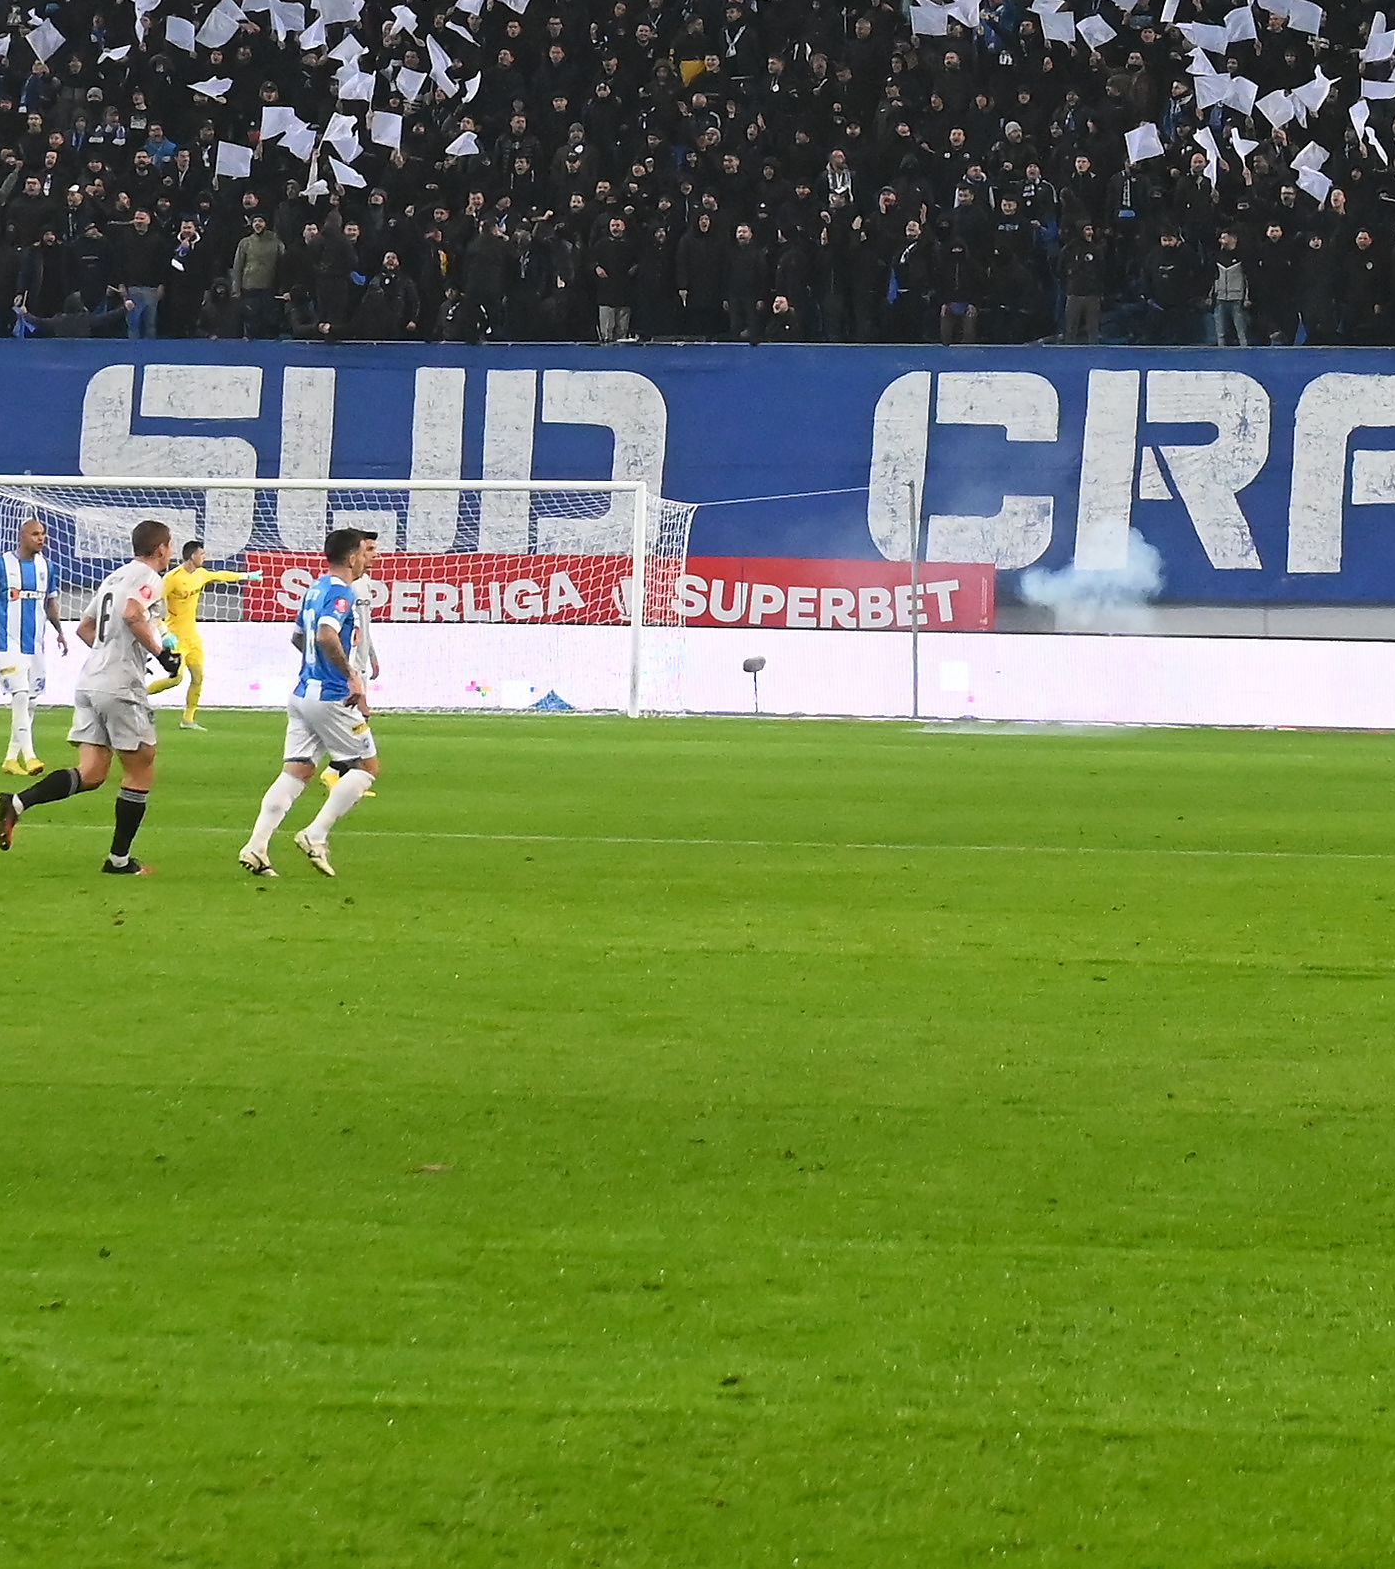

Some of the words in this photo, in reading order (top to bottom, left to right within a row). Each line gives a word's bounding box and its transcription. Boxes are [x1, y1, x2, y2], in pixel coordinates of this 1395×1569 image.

[74, 363, 667, 560] SUD
[276, 569, 586, 623] SPERLIGA
[673, 574, 960, 630] SUPERBET
